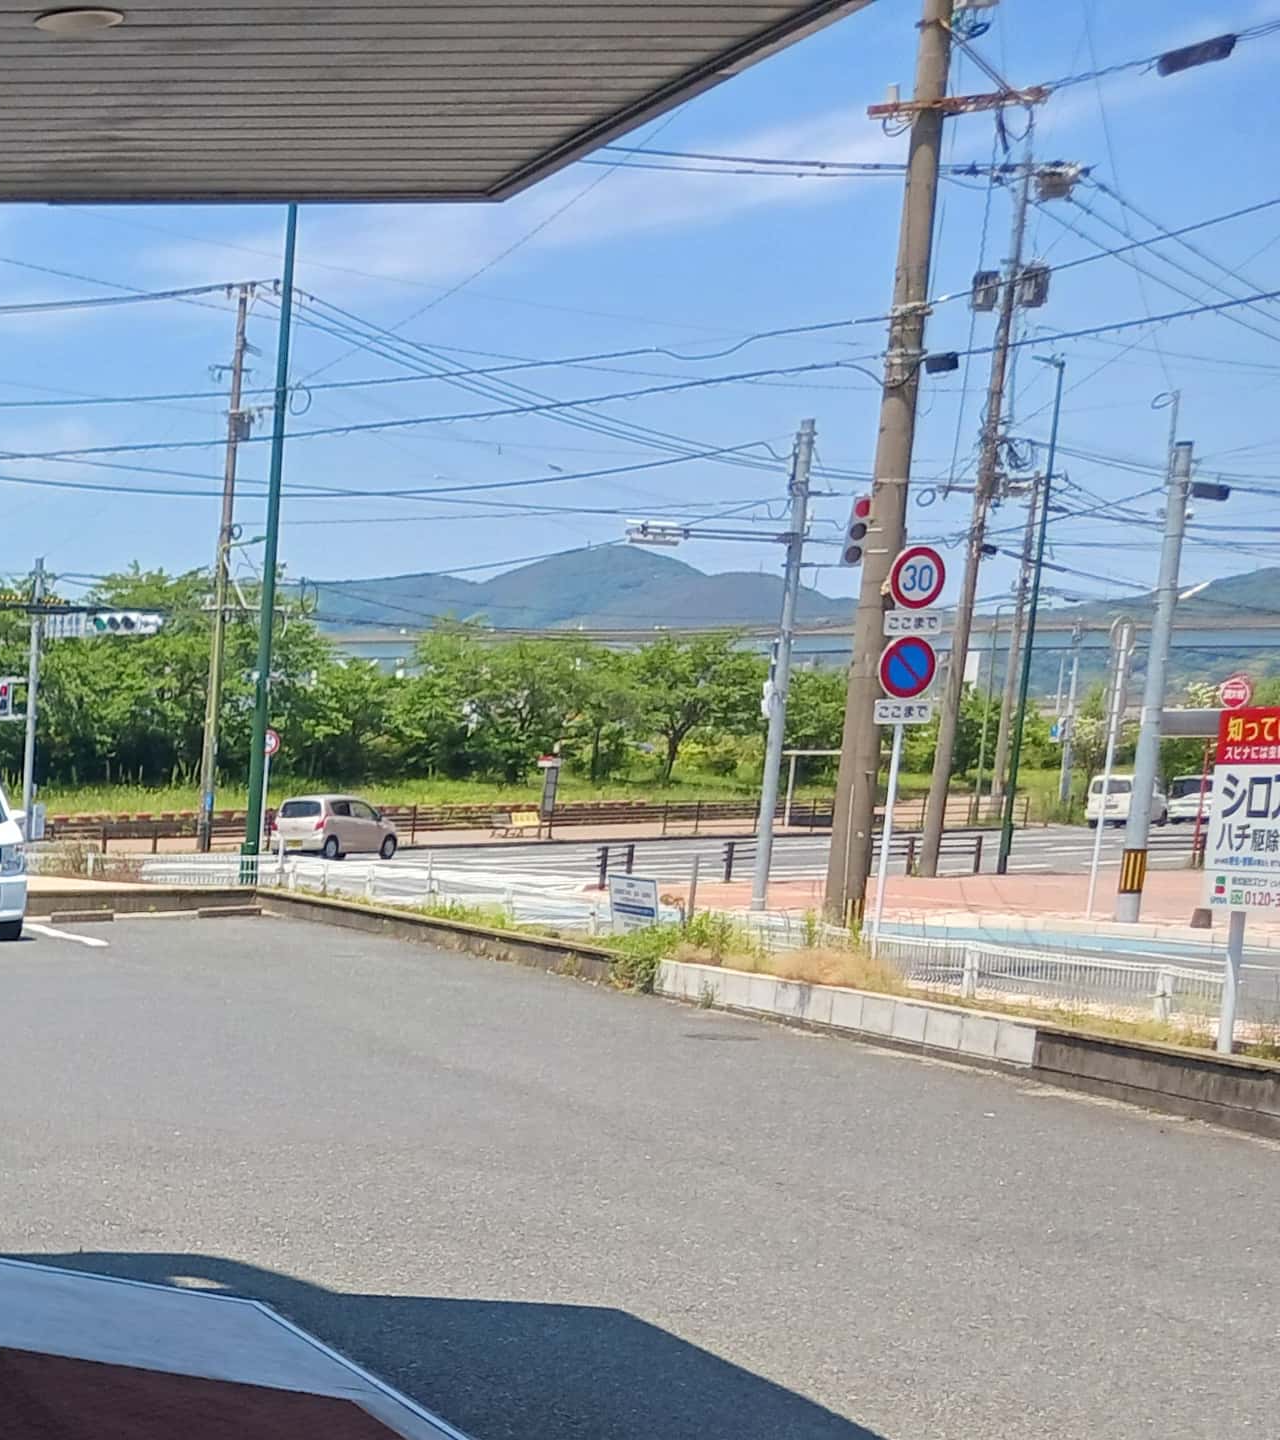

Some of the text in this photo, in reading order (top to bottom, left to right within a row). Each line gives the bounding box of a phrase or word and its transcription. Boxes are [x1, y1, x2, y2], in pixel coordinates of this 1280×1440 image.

[902, 565, 934, 593] 30
[888, 616, 938, 630] ここまで
[878, 706, 929, 719] ここまで
[1226, 716, 1280, 742] 知って
[1216, 823, 1279, 852] ハチ駆除
